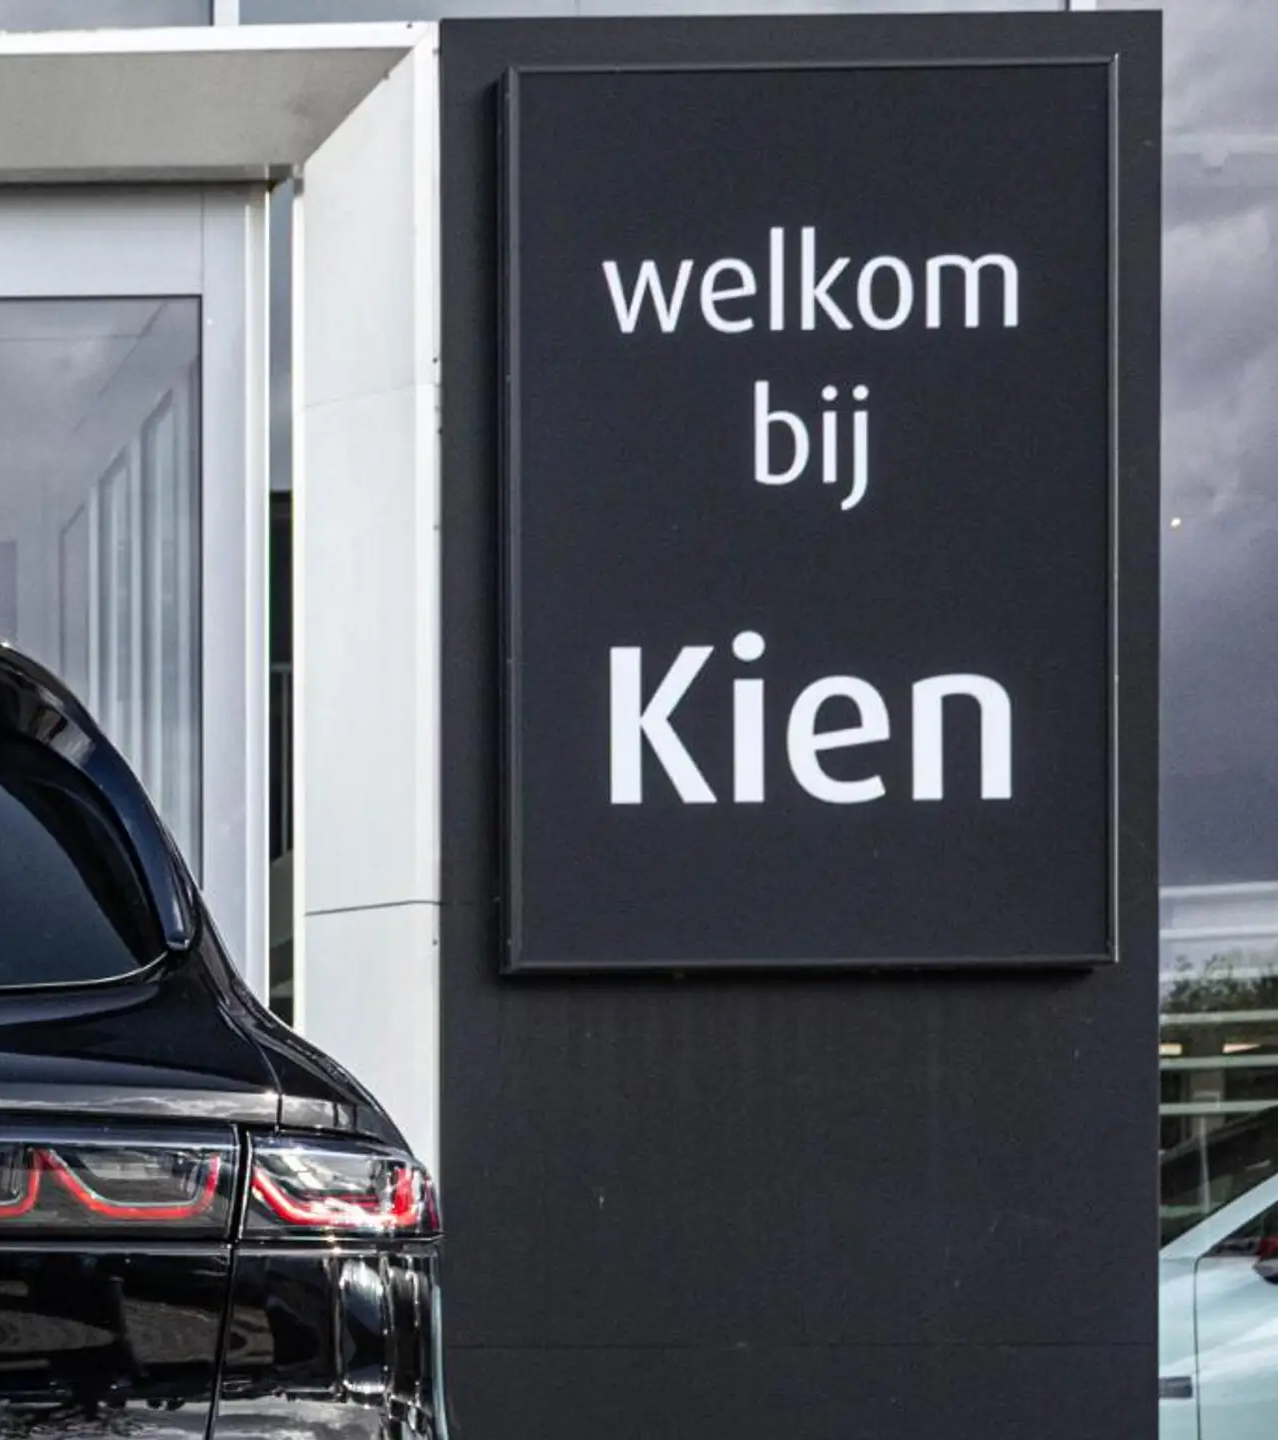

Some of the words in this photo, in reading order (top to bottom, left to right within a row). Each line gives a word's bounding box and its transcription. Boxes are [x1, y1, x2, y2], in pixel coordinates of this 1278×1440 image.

[602, 226, 1019, 333] welkom
[753, 380, 870, 511] bij
[608, 630, 1013, 805] Kien
